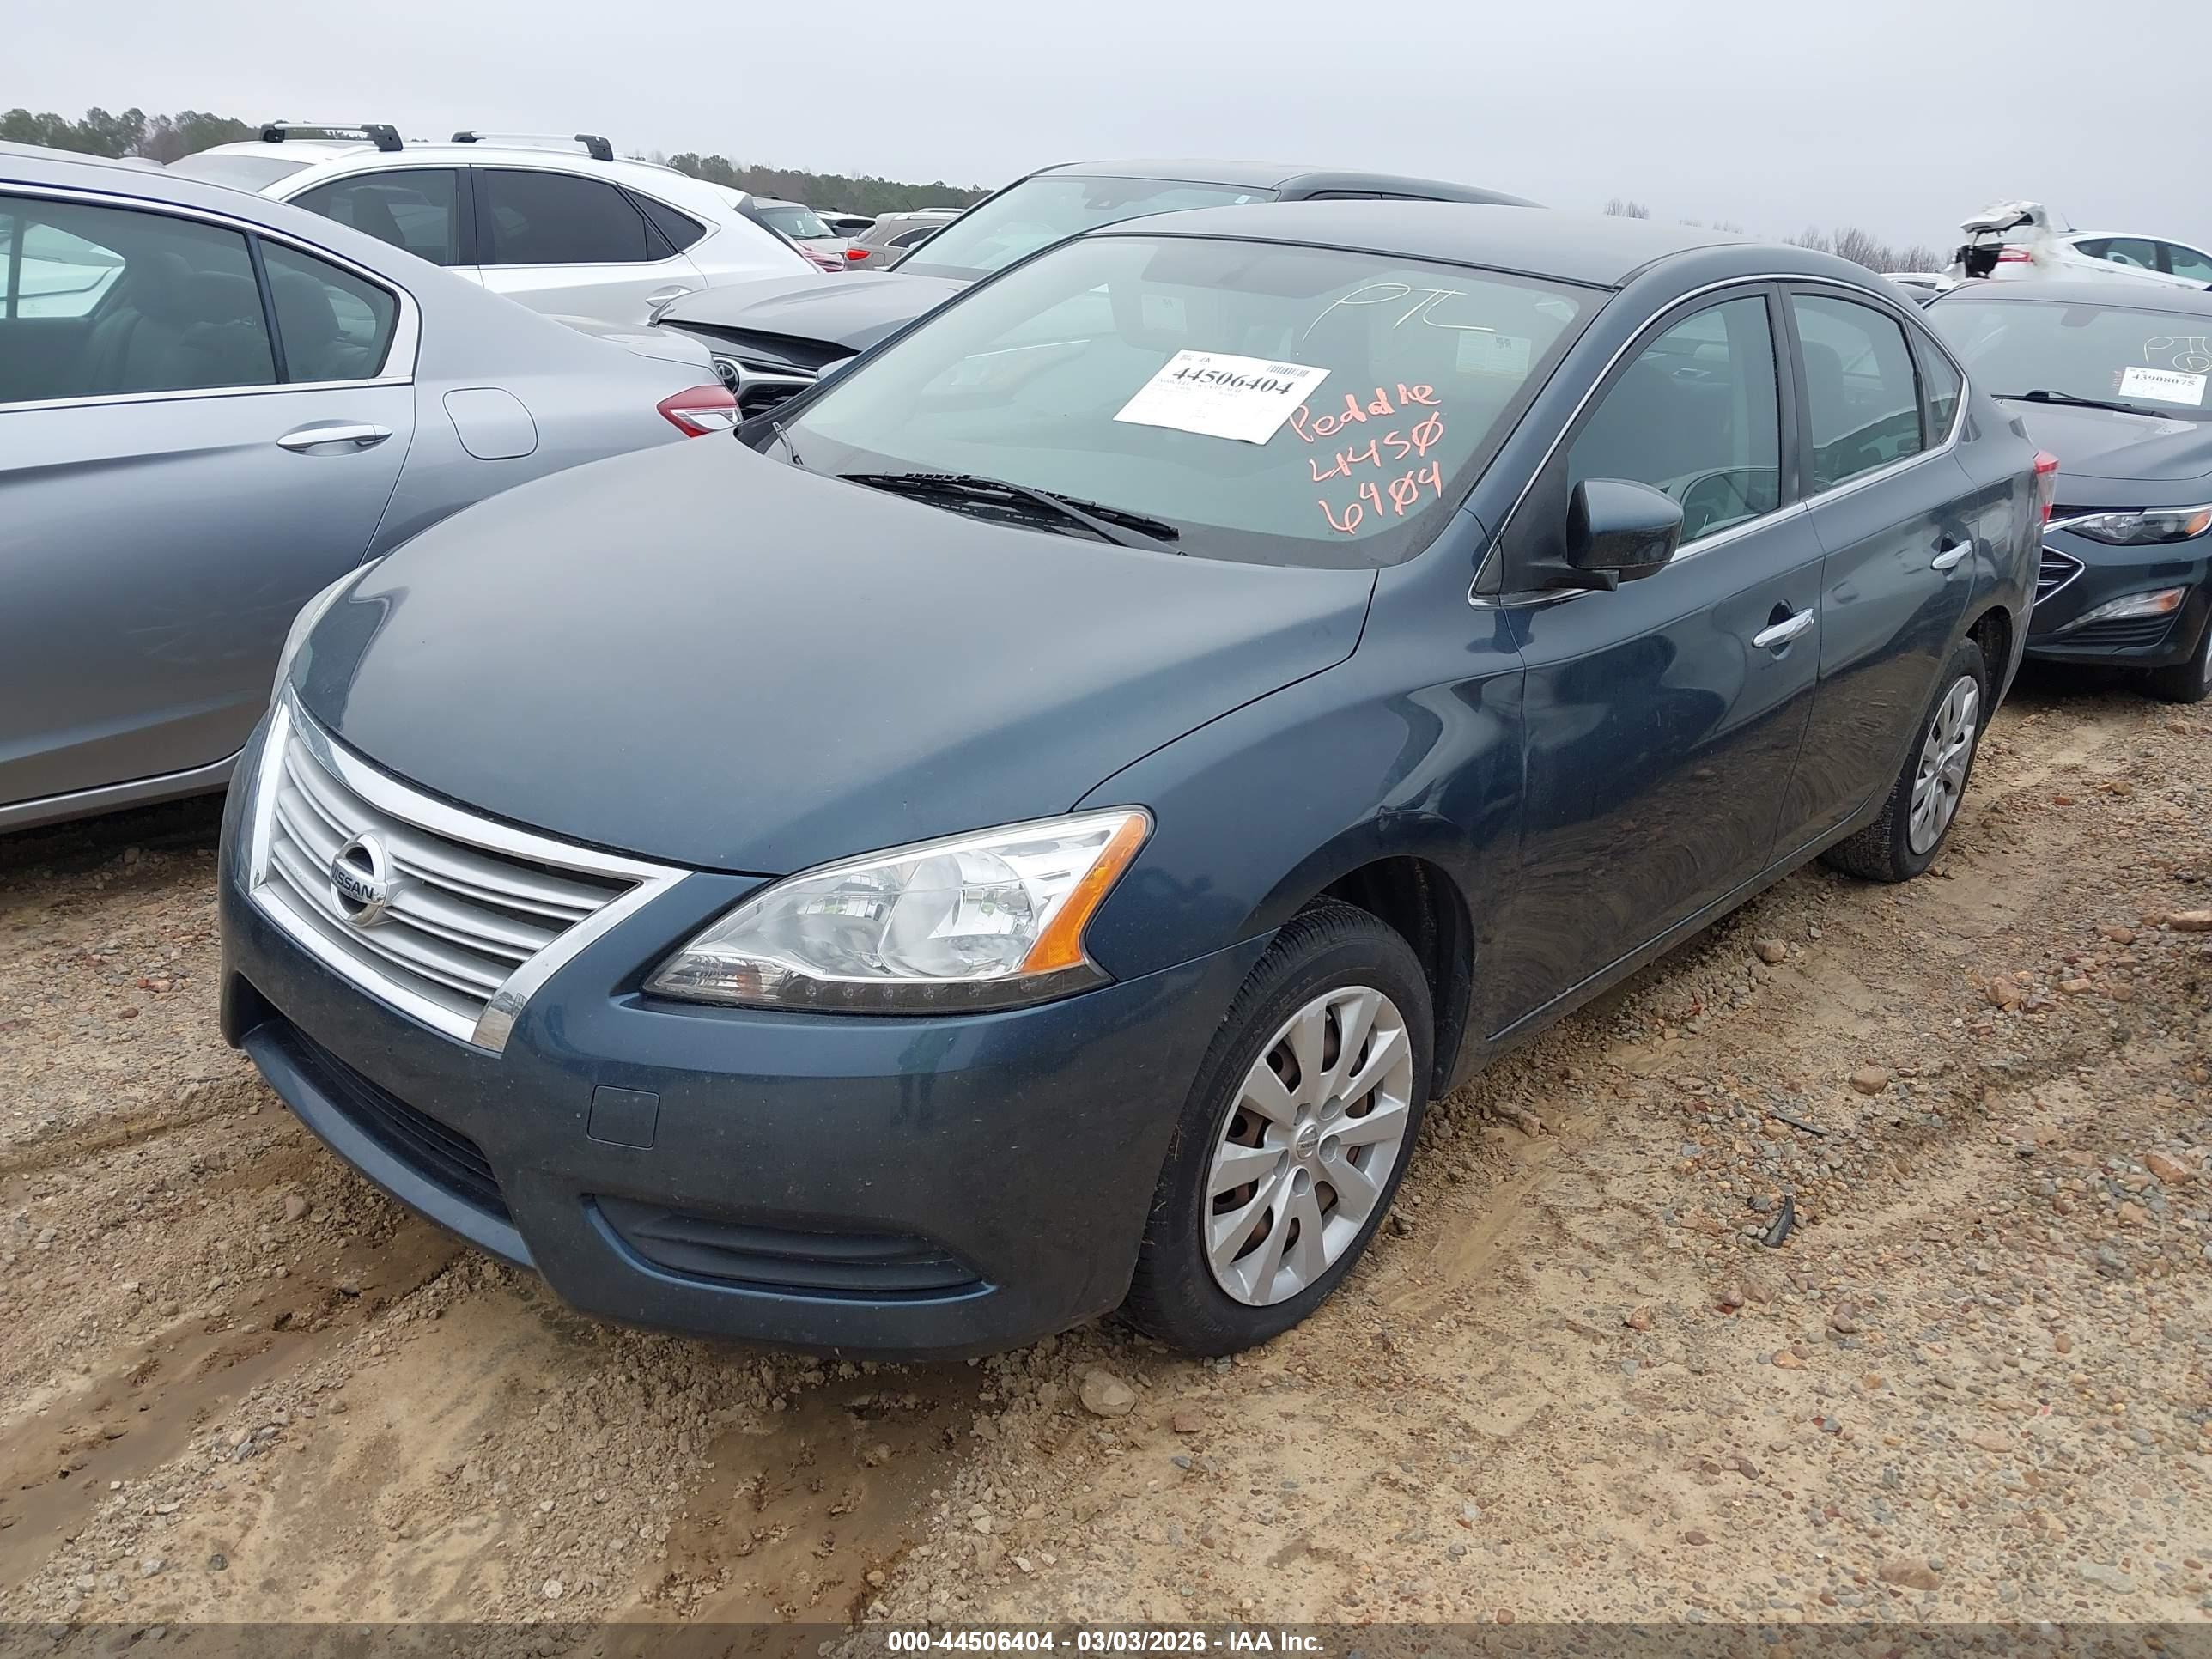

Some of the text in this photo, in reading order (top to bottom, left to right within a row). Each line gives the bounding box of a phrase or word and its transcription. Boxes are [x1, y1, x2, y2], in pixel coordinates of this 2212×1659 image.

[1172, 367, 1295, 395] 44506404
[1318, 460, 1443, 535] 6404
[331, 865, 374, 900] NISSAN
